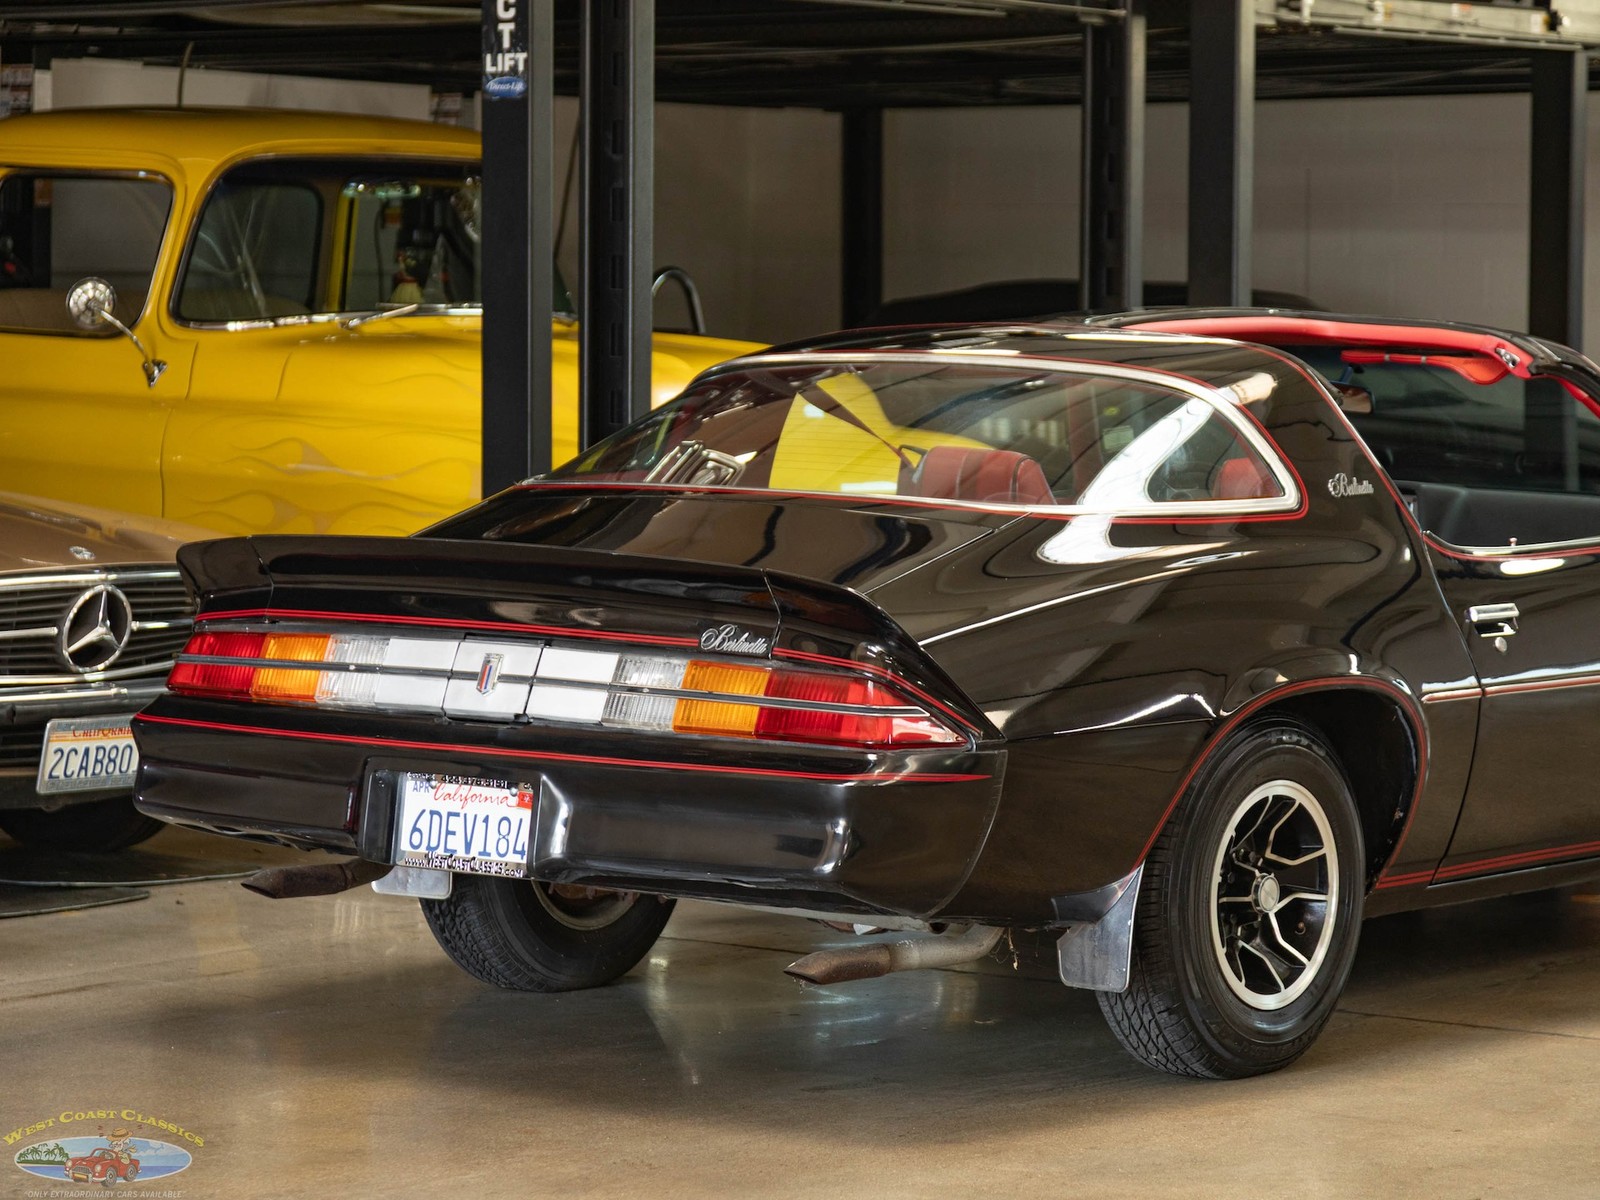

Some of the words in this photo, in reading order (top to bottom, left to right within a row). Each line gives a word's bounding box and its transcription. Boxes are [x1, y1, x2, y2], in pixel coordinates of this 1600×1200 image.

[485, 52, 528, 74] LIFT
[700, 623, 768, 654] Berlinetta
[48, 743, 137, 780] 2CAB80
[412, 780, 431, 794] APR
[433, 782, 518, 809] California
[409, 808, 526, 860] 6DEV184
